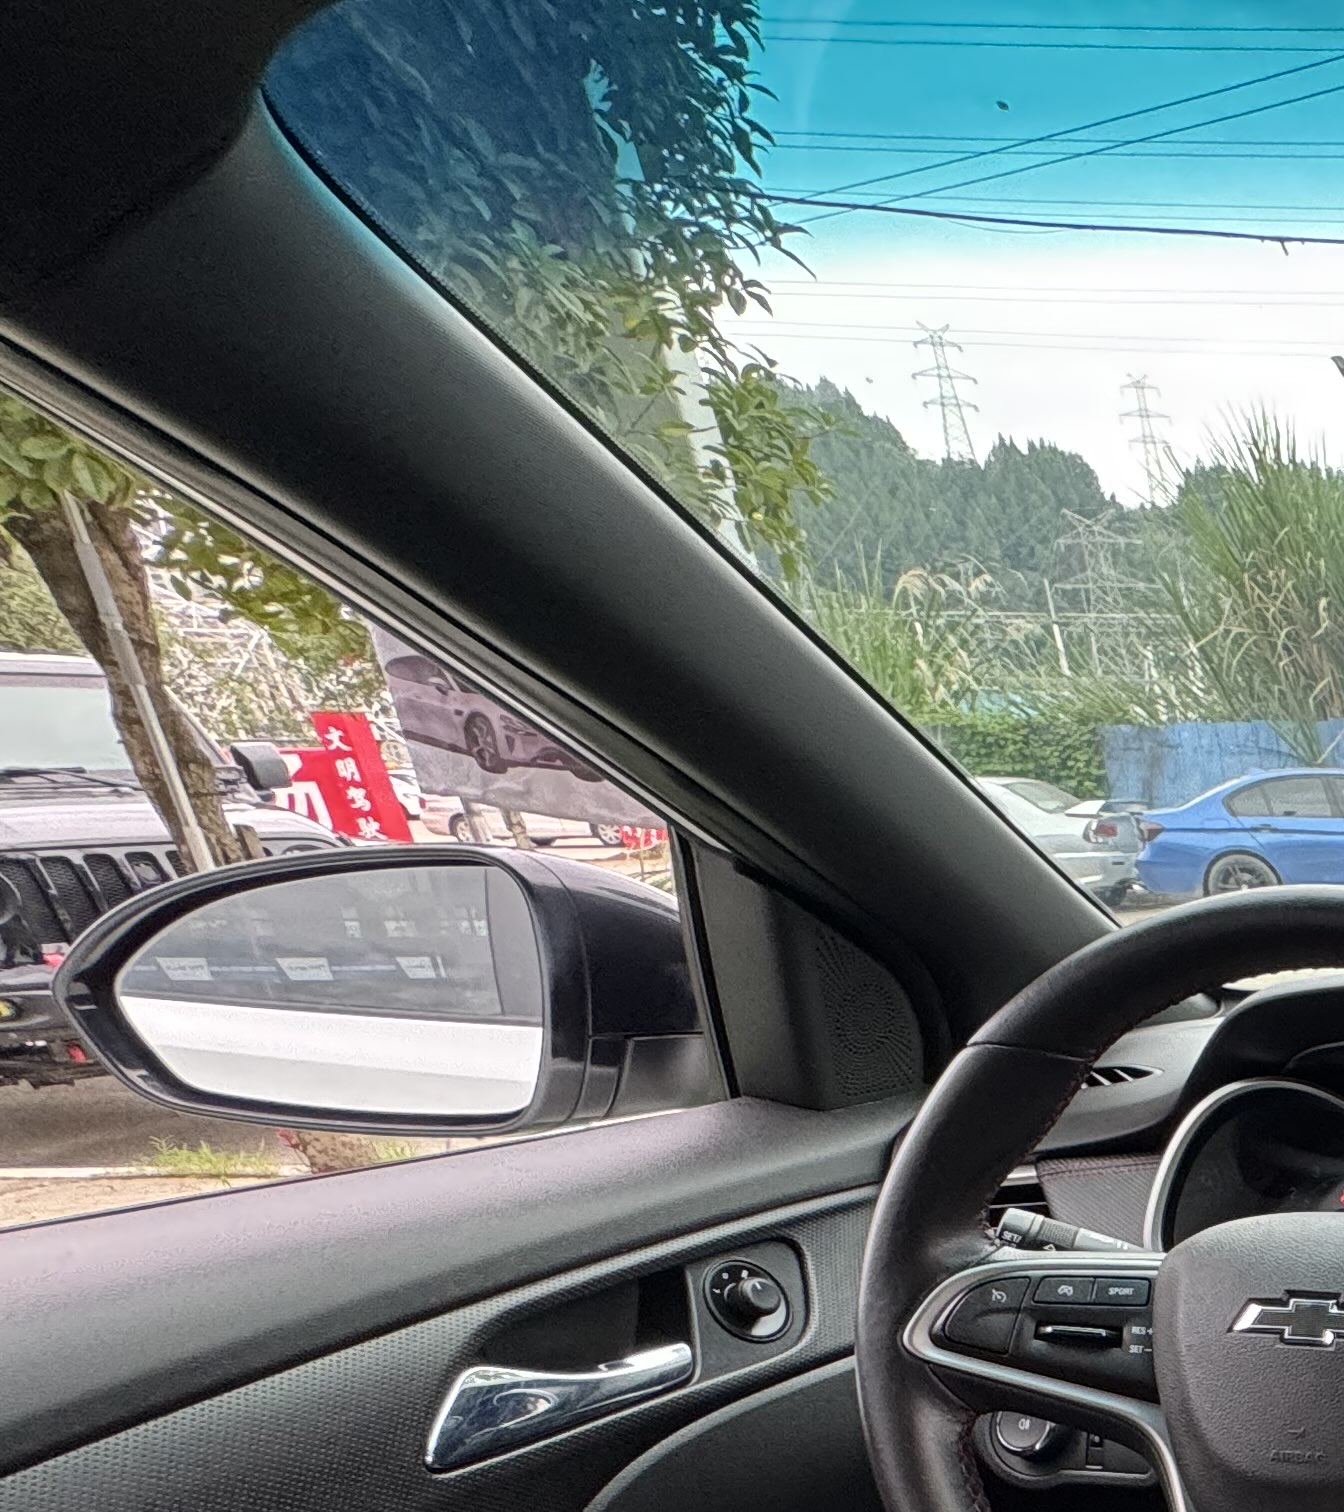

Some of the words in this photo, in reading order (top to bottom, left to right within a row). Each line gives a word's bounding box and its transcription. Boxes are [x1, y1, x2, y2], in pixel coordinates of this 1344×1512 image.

[324, 726, 388, 840] 文明驾驶
[1107, 1286, 1135, 1296] SPORT
